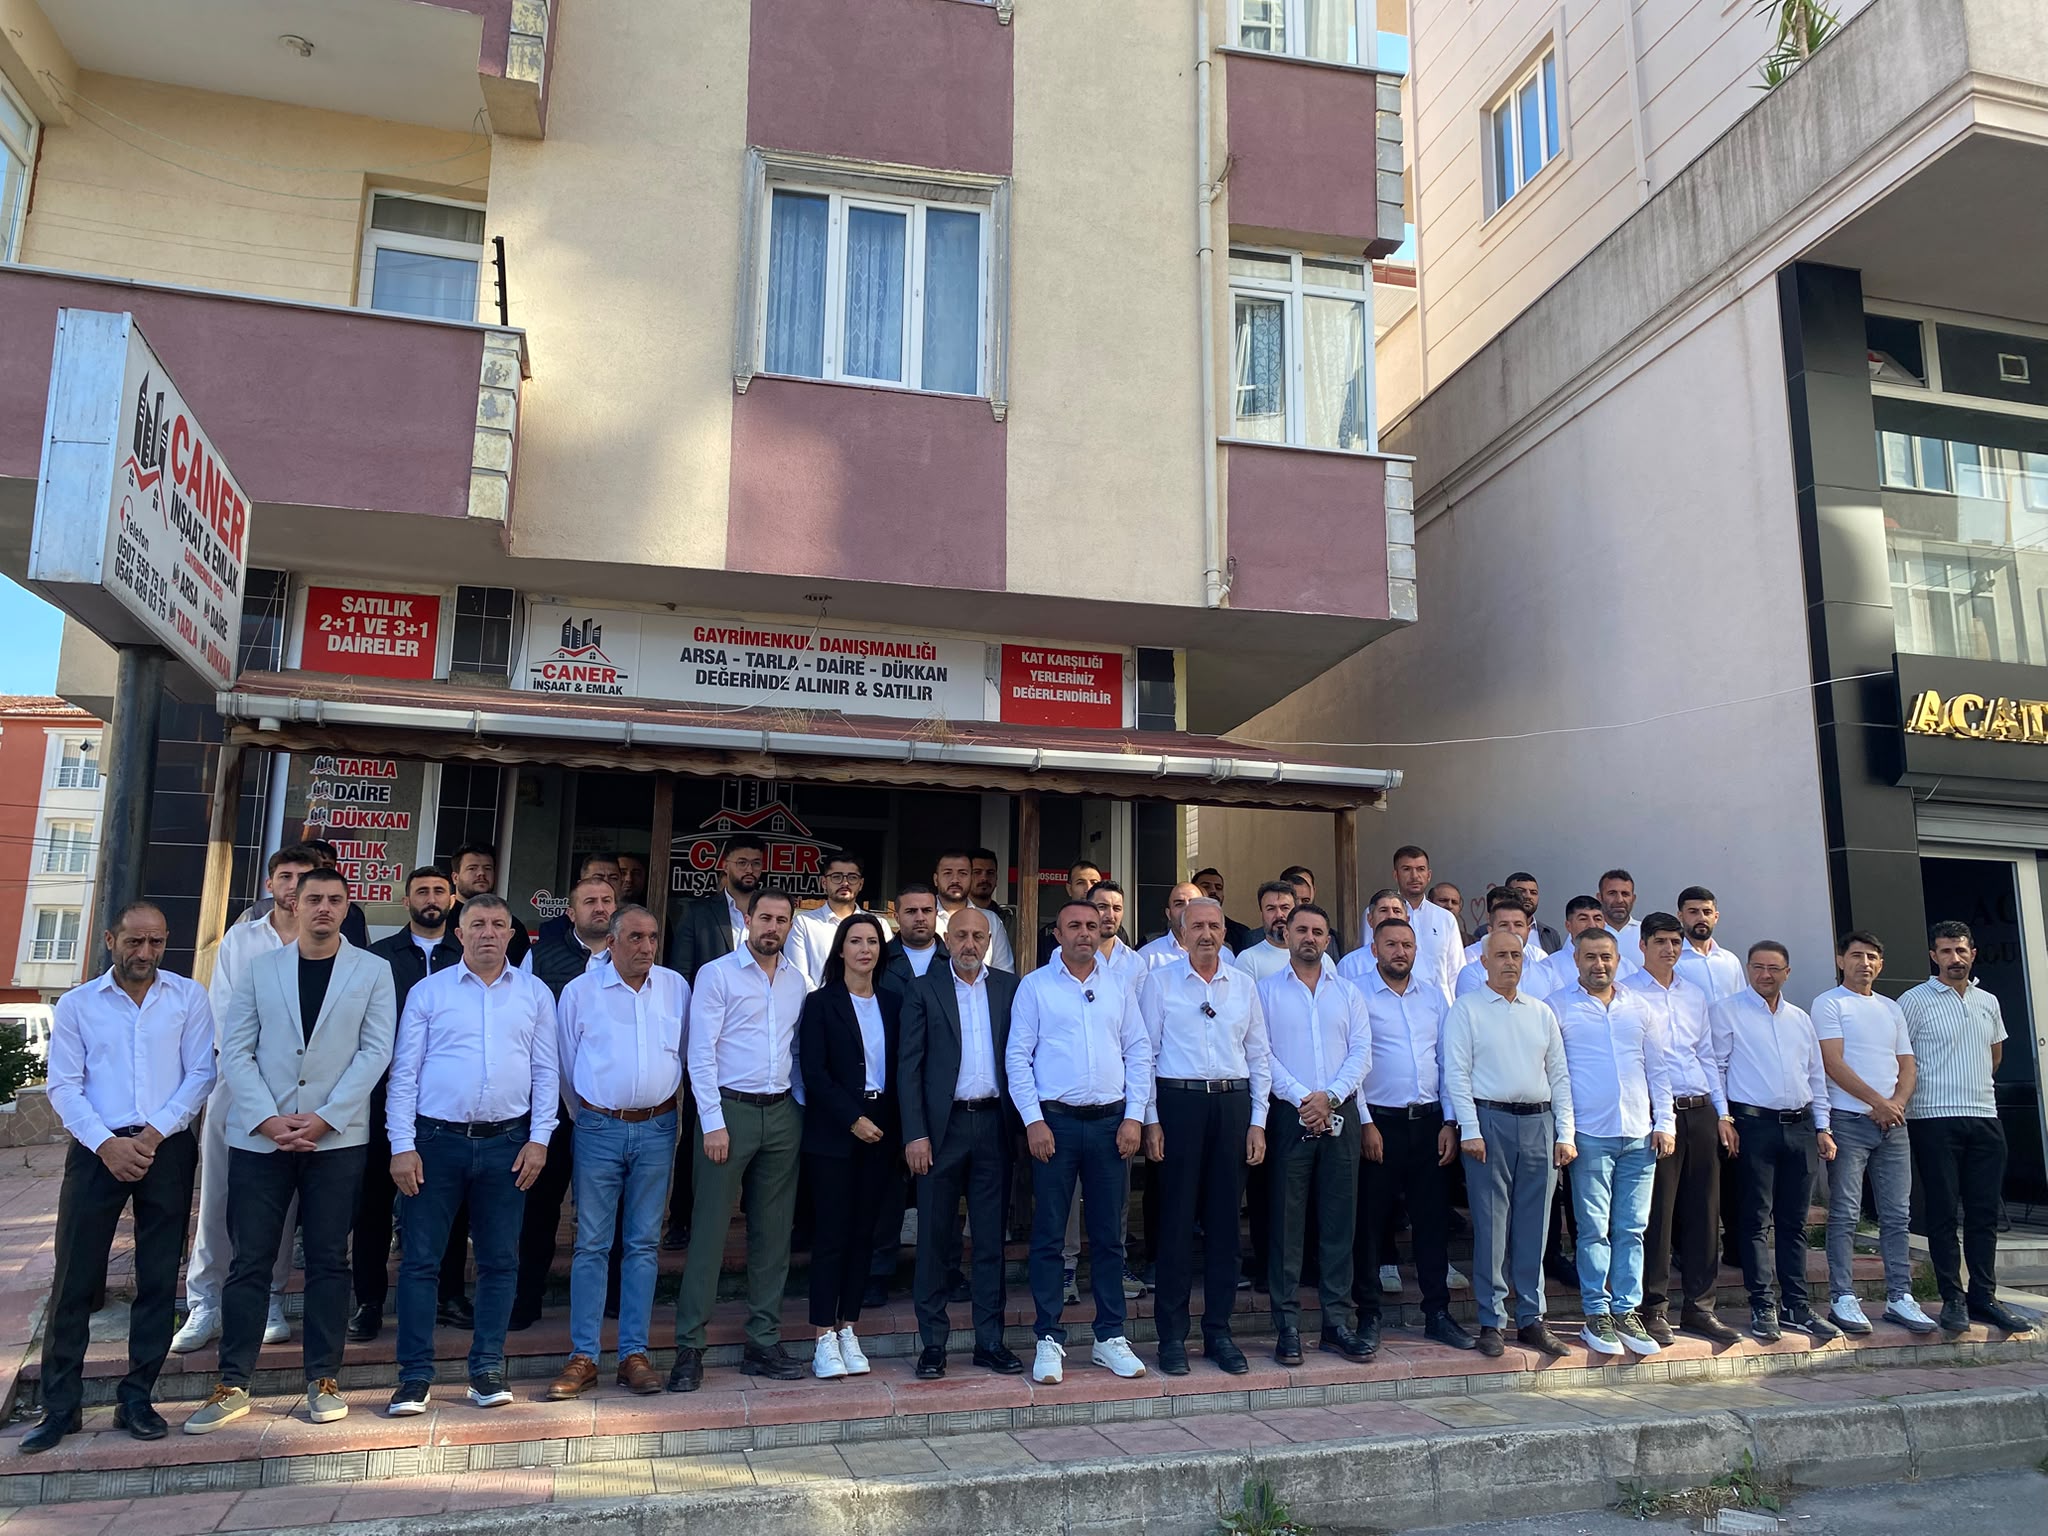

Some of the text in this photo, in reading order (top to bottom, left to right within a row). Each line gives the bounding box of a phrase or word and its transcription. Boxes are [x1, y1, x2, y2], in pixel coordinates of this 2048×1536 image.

[172, 414, 245, 564] CANER
[126, 514, 149, 552] Telefon
[171, 483, 239, 596] İNŞAAT & EMLAK
[117, 534, 168, 600] 0507 556 75 01
[115, 556, 166, 621] 0546 489 03 75
[179, 572, 198, 609] ARSA
[341, 596, 413, 618] SATILIK
[176, 607, 198, 649] TARLA
[210, 605, 228, 641] DAİRE
[319, 614, 428, 639] 2+1 VE 3+1
[327, 632, 419, 657] DAİRELER
[693, 626, 936, 662] GAYRİMENKUL DANIŞMANLIĞI
[207, 639, 231, 681] DÜKKAN
[680, 647, 727, 665] ARSA
[745, 651, 799, 671] TARLA
[816, 655, 864, 676] DAİRE
[882, 659, 948, 682] DÜKKAN
[1021, 652, 1103, 670] KAT KARŞILIĞI
[533, 677, 623, 696] İNŞAAT & EMLAK
[542, 664, 616, 684] CANER
[695, 667, 933, 701] DEĞERİNDE ALINIR & SATILIR
[1030, 670, 1095, 685] YERLERİNİZ
[1013, 685, 1111, 704] DEĞERLENDİRİLİR
[337, 758, 397, 779] TARLA
[334, 781, 390, 803] DAİRE
[331, 807, 410, 830] DÜKKAN
[329, 840, 387, 860] ATILIK
[689, 839, 822, 874] CER
[336, 862, 403, 882] VE 3+1
[673, 866, 718, 897] İNŞA
[347, 883, 392, 901] ELER
[539, 898, 570, 906] Mustaf
